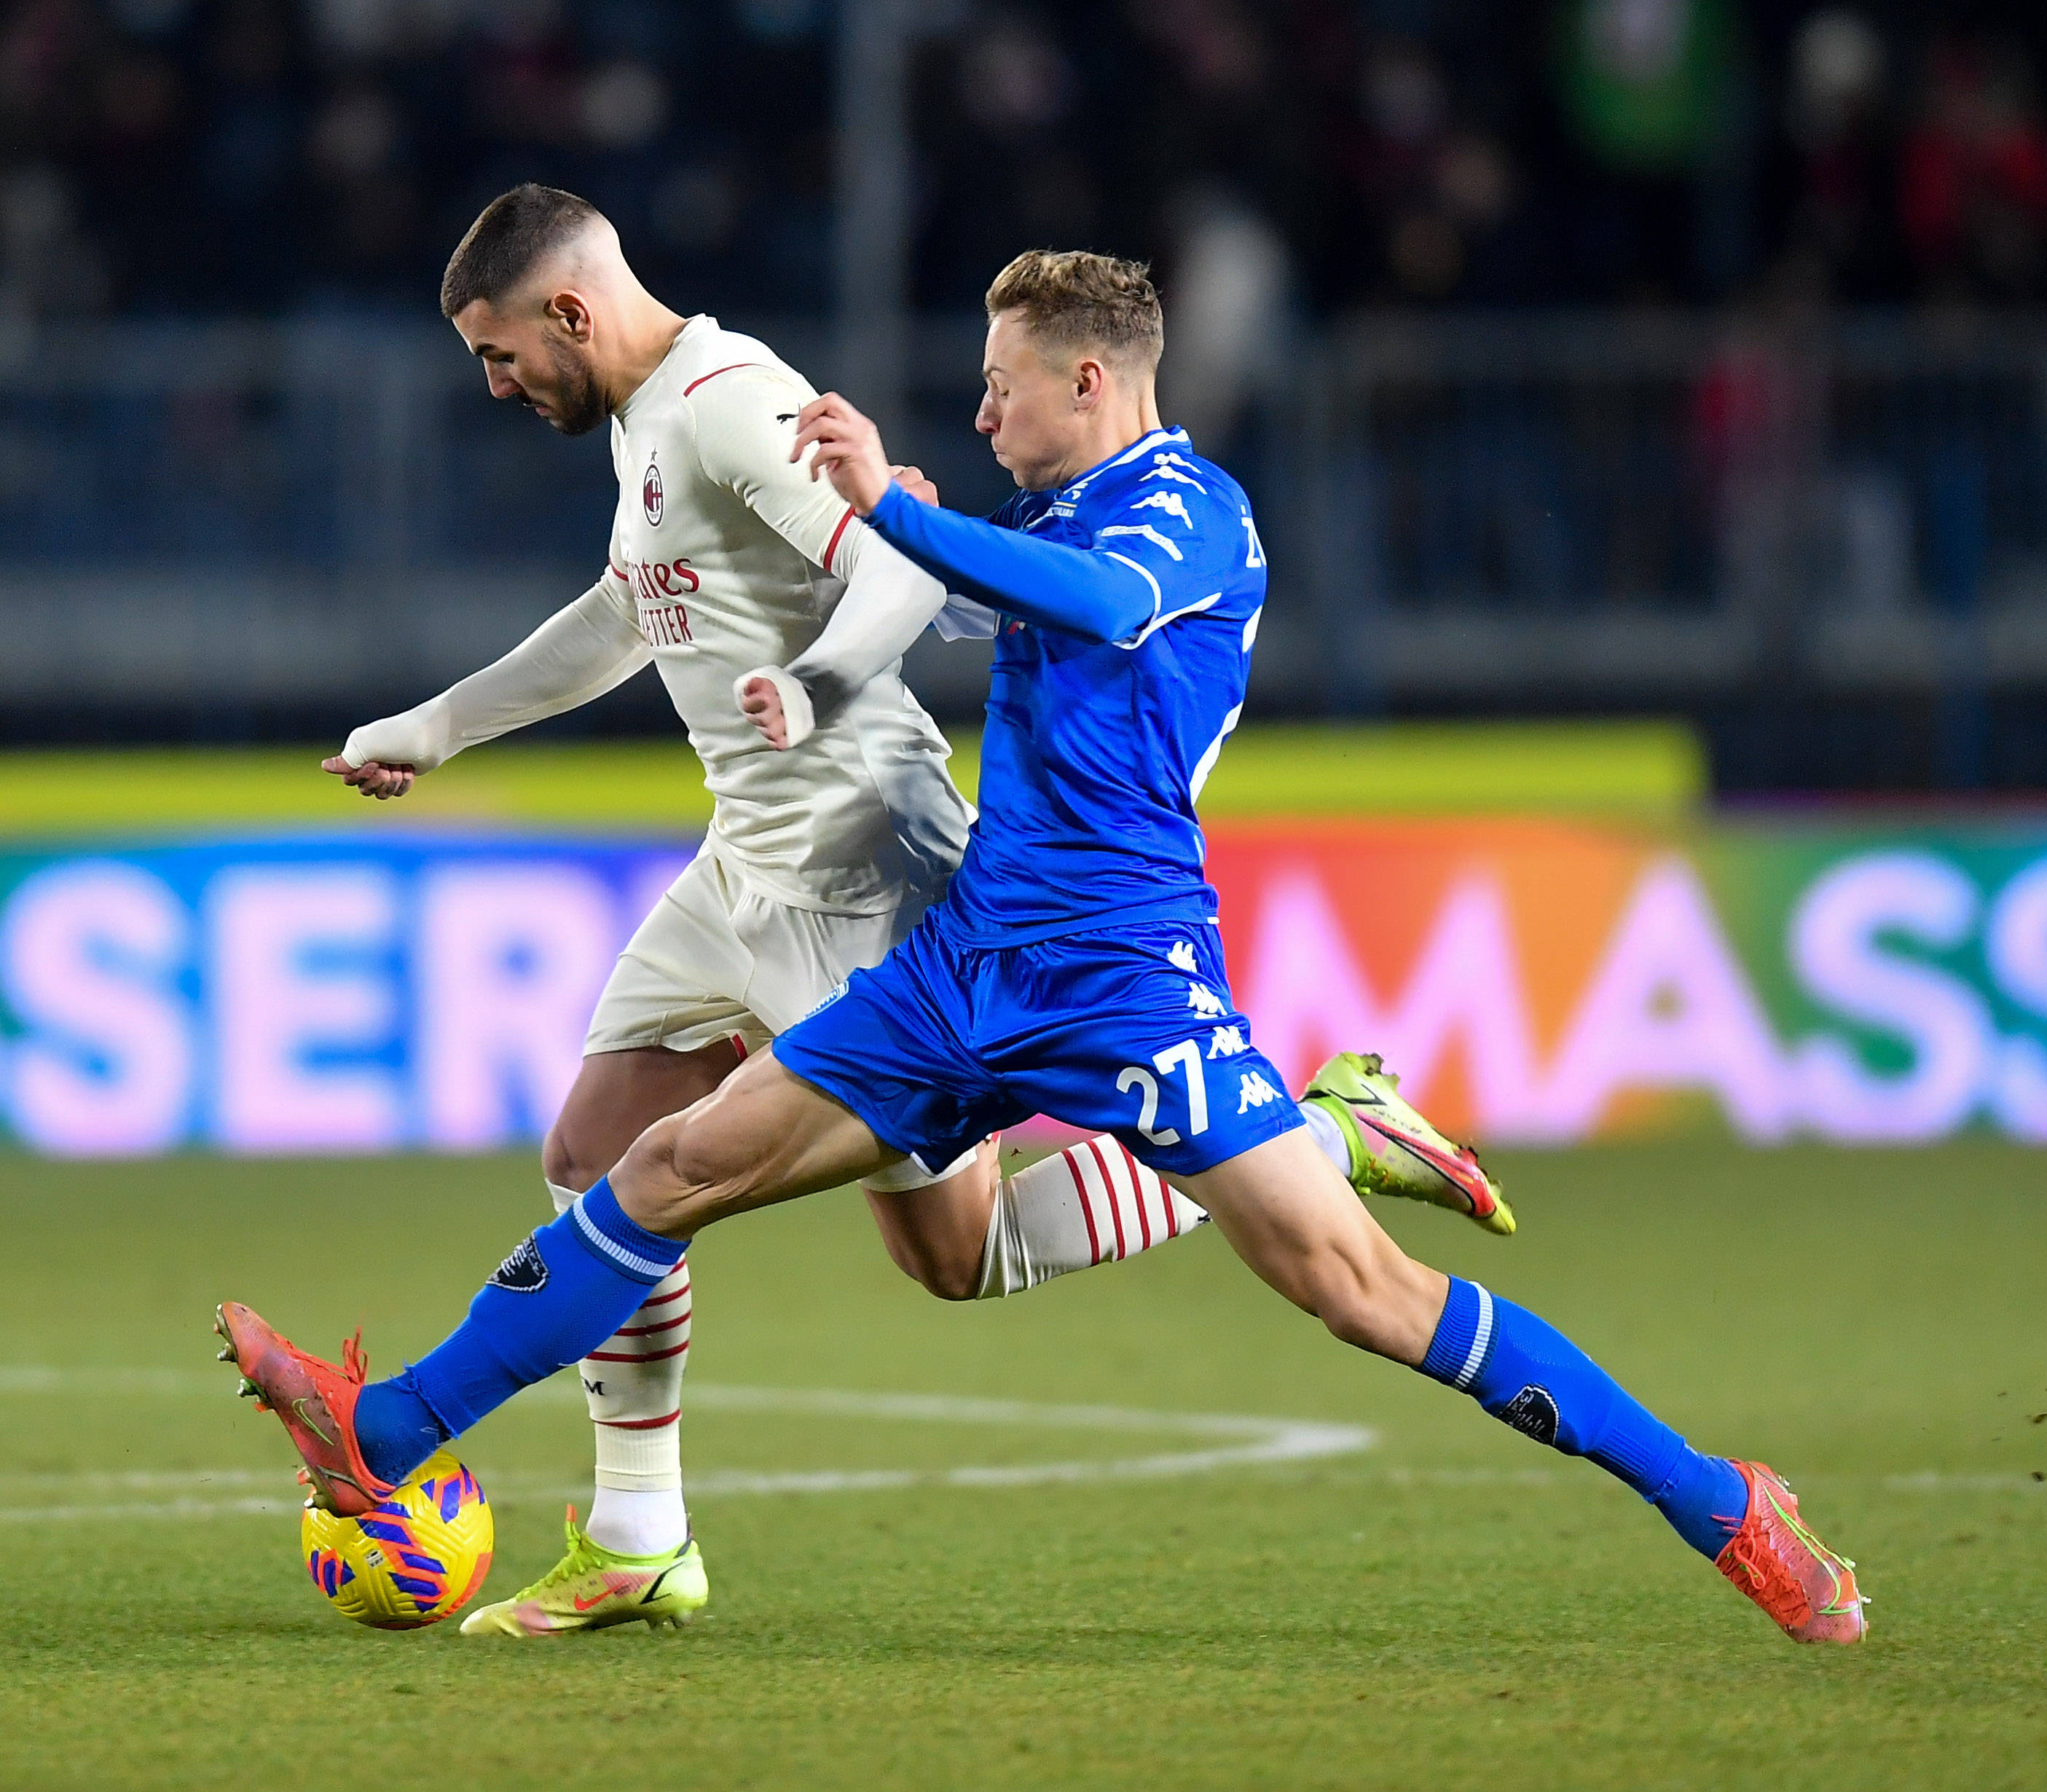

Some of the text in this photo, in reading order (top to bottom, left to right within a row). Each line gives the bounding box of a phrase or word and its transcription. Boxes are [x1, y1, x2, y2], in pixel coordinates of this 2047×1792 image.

[641, 604, 693, 647] ETTER
[4, 858, 692, 1157] SER
[1116, 1039, 1209, 1146] 27
